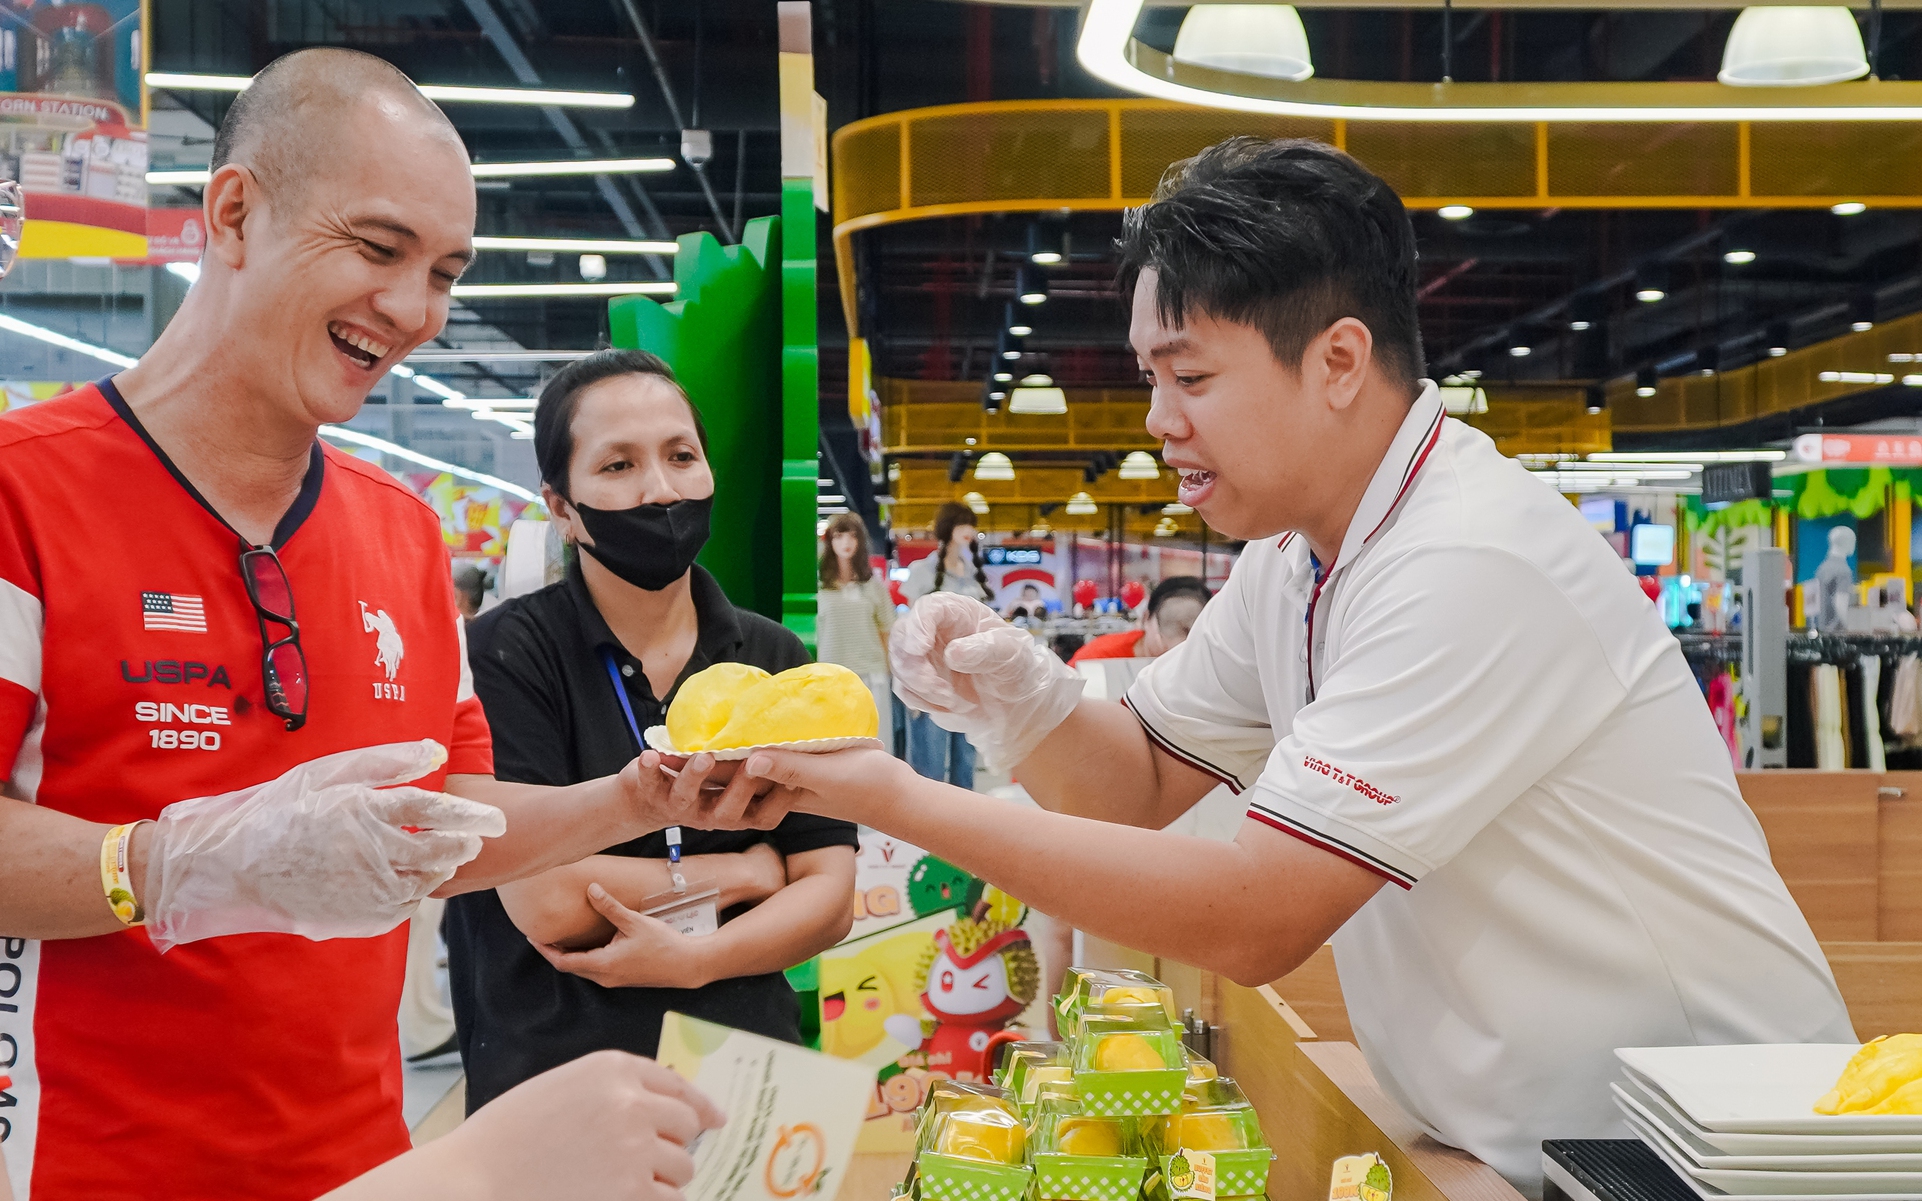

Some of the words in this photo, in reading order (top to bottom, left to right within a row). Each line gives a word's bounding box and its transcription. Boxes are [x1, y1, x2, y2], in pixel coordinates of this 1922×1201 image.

[40, 100, 110, 120] STATION
[120, 660, 232, 689] USPA
[135, 701, 232, 726] SINCE
[149, 729, 221, 751] 1890
